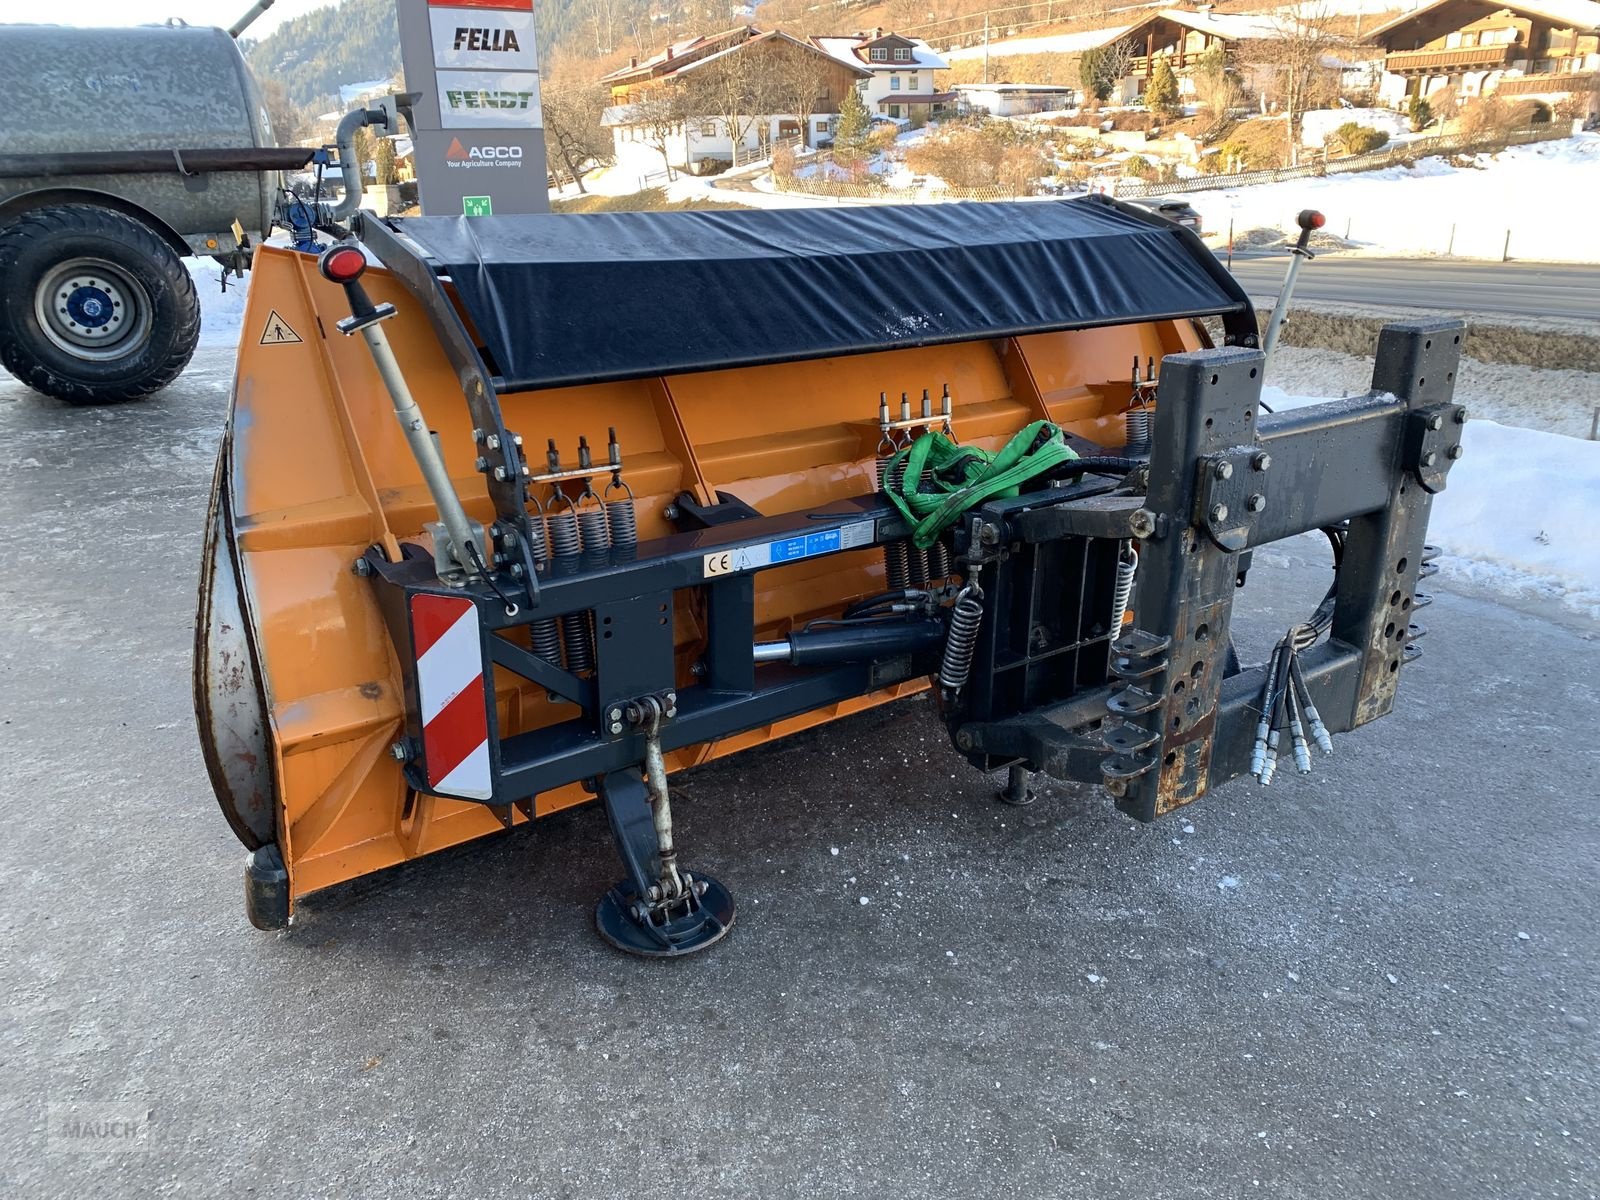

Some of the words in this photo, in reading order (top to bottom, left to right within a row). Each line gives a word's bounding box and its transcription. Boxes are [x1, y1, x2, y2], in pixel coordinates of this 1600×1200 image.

[453, 27, 520, 52] FELLA
[446, 90, 533, 109] FENDT
[468, 146, 523, 159] AGCO
[446, 160, 460, 168] Your
[461, 160, 494, 168] Agriculture
[494, 159, 522, 168] Company
